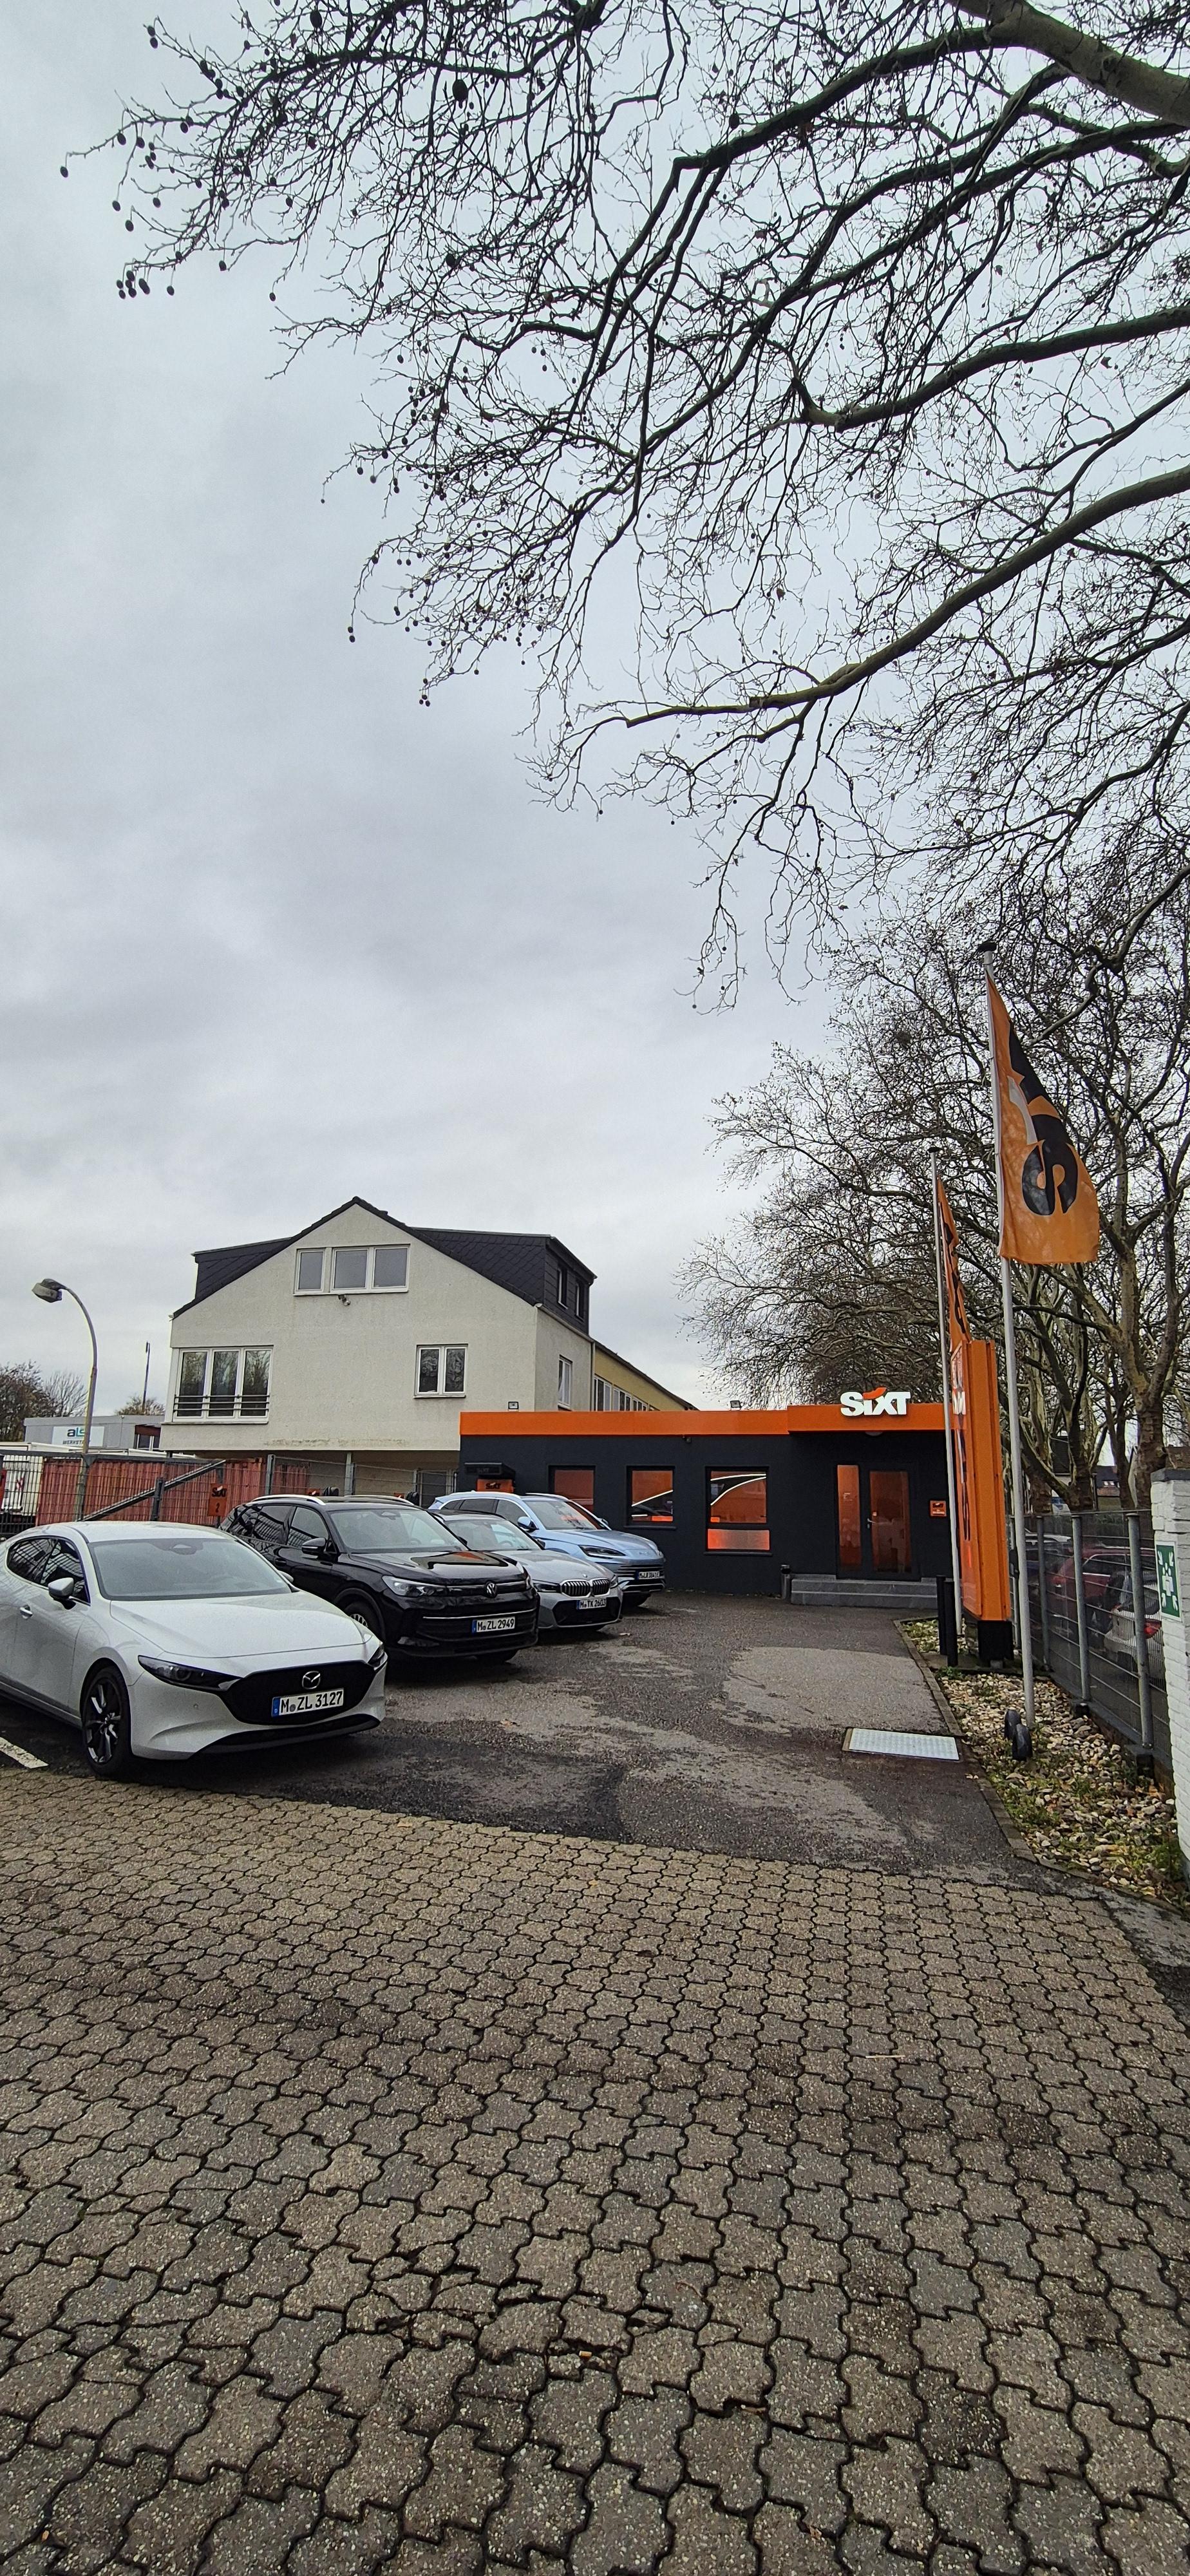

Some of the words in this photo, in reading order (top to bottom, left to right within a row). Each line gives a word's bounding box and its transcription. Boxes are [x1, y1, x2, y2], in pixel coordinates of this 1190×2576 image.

[216, 1503, 220, 1512] 2
[477, 1622, 483, 1631] M
[487, 1620, 496, 1629] ZL
[498, 1618, 514, 1629] 2949
[281, 1698, 289, 1712] M
[297, 1696, 312, 1711] ZL
[316, 1690, 343, 1707] 3127
